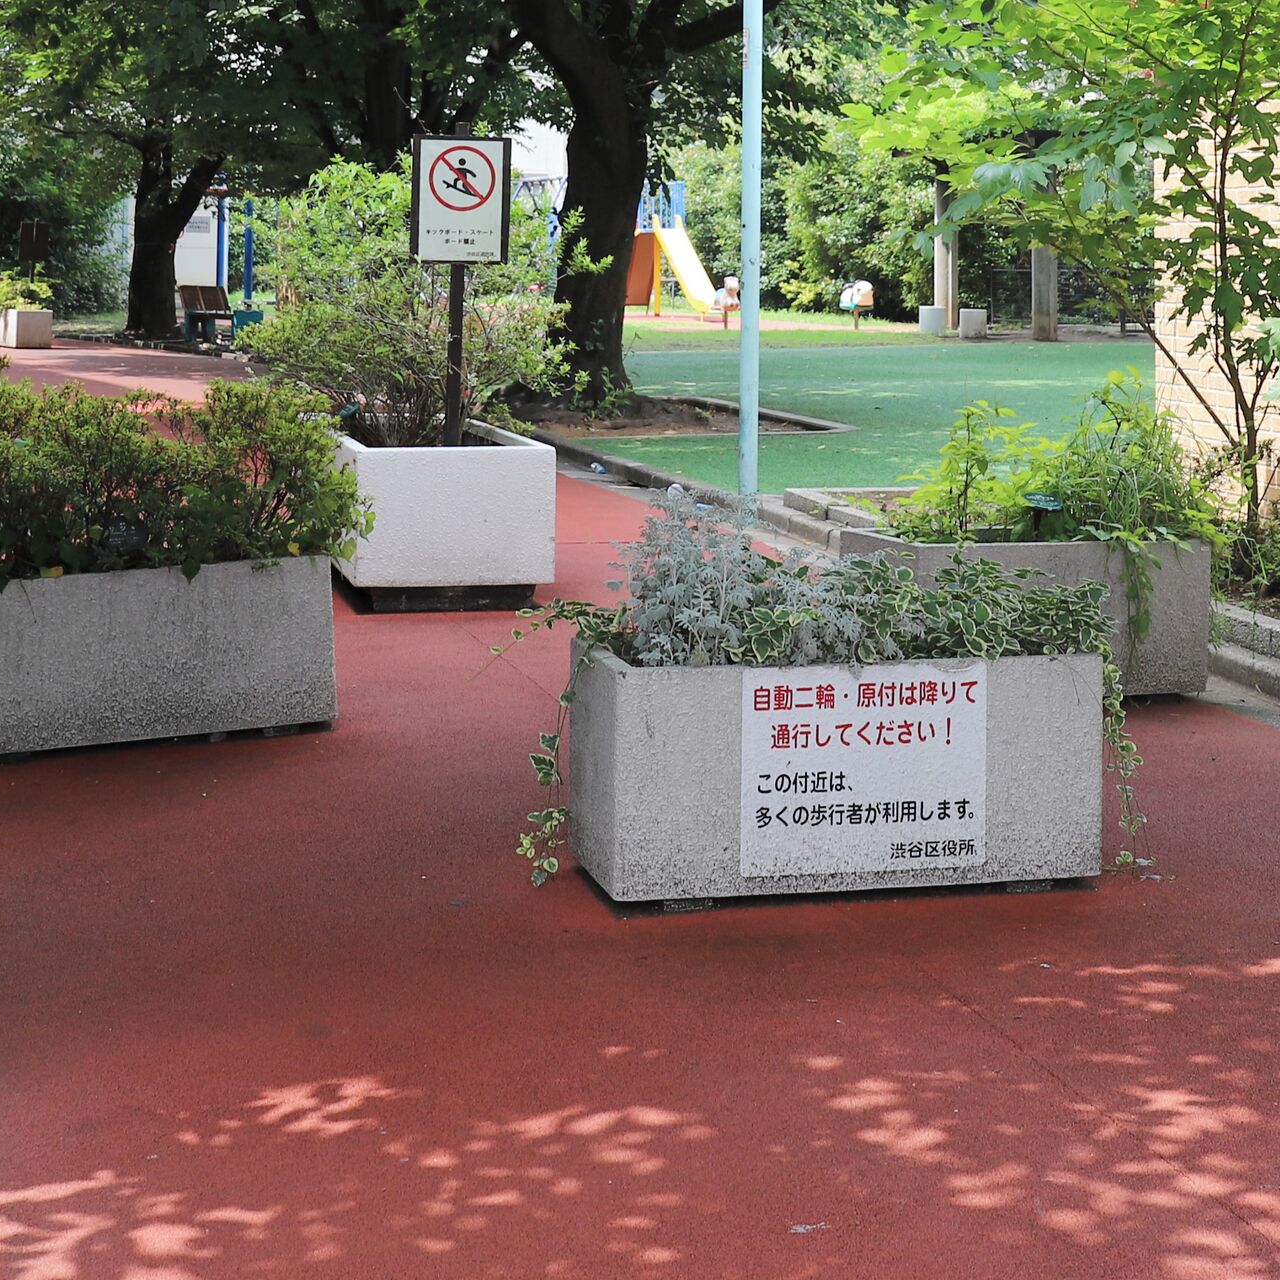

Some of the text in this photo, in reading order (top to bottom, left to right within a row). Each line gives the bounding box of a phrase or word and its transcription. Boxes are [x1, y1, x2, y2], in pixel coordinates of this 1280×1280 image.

[753, 680, 979, 712] 自動二輪・原付は降りて
[770, 717, 953, 750] 通行してください！
[756, 771, 855, 794] この付近は、
[755, 798, 975, 828] 多くの歩行者が利用します。
[890, 839, 977, 860] 渋谷区役所
